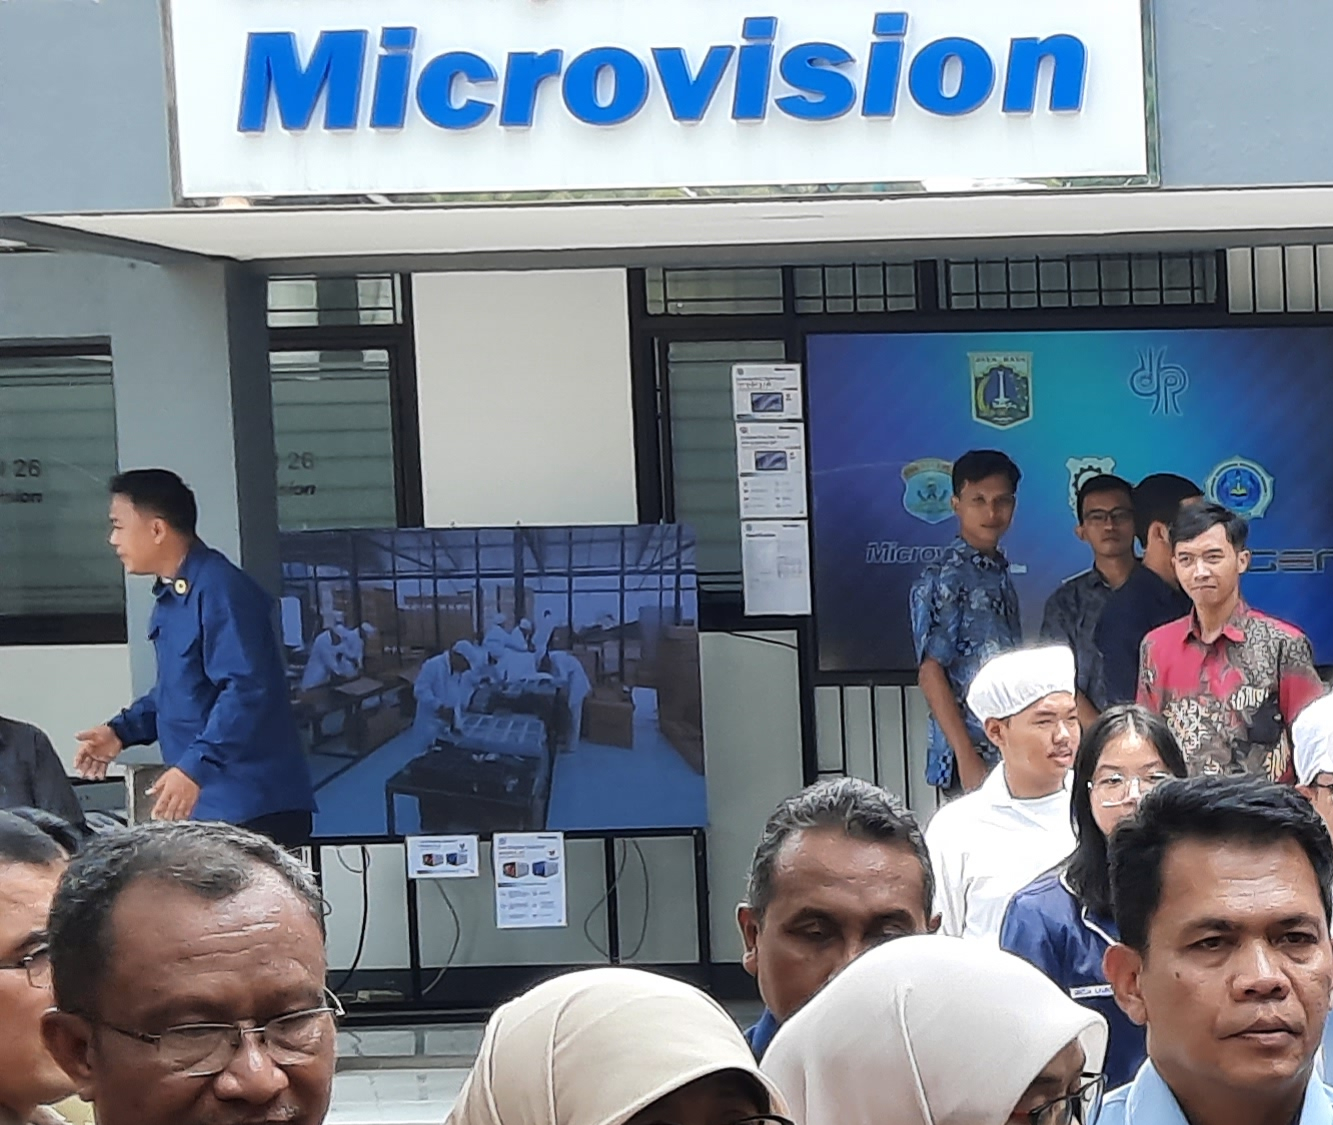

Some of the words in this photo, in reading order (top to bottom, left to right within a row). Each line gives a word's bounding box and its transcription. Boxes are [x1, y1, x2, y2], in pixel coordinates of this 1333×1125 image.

[239, 12, 1088, 131] Microvision
[13, 458, 41, 478] 26
[287, 452, 315, 470] 26
